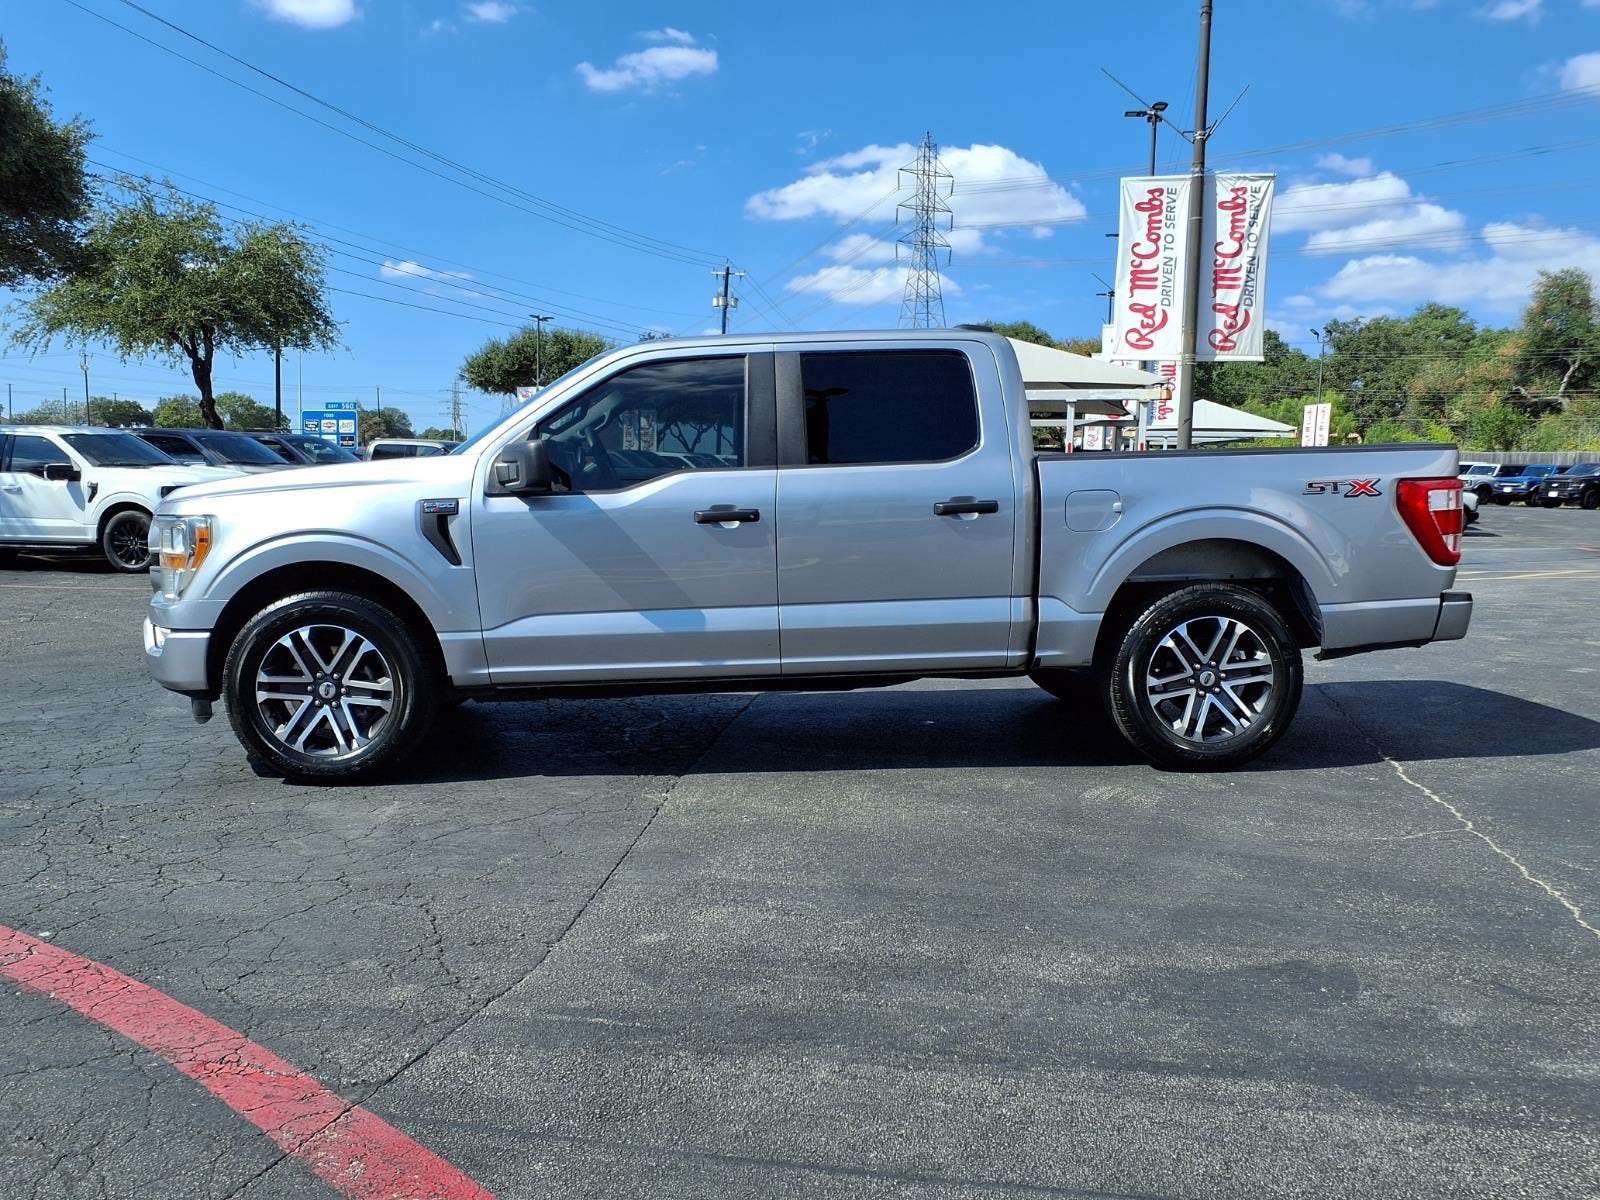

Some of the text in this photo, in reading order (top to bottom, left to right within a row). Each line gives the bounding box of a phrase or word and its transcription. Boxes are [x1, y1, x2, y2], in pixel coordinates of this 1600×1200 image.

[1125, 187, 1168, 350] Red McCombs
[1160, 187, 1177, 307] DRIVEN TO SERVE
[1208, 186, 1251, 351] Red McCombs
[1243, 186, 1261, 307] DRIVEN TO SERVE
[1303, 478, 1382, 498] STX
